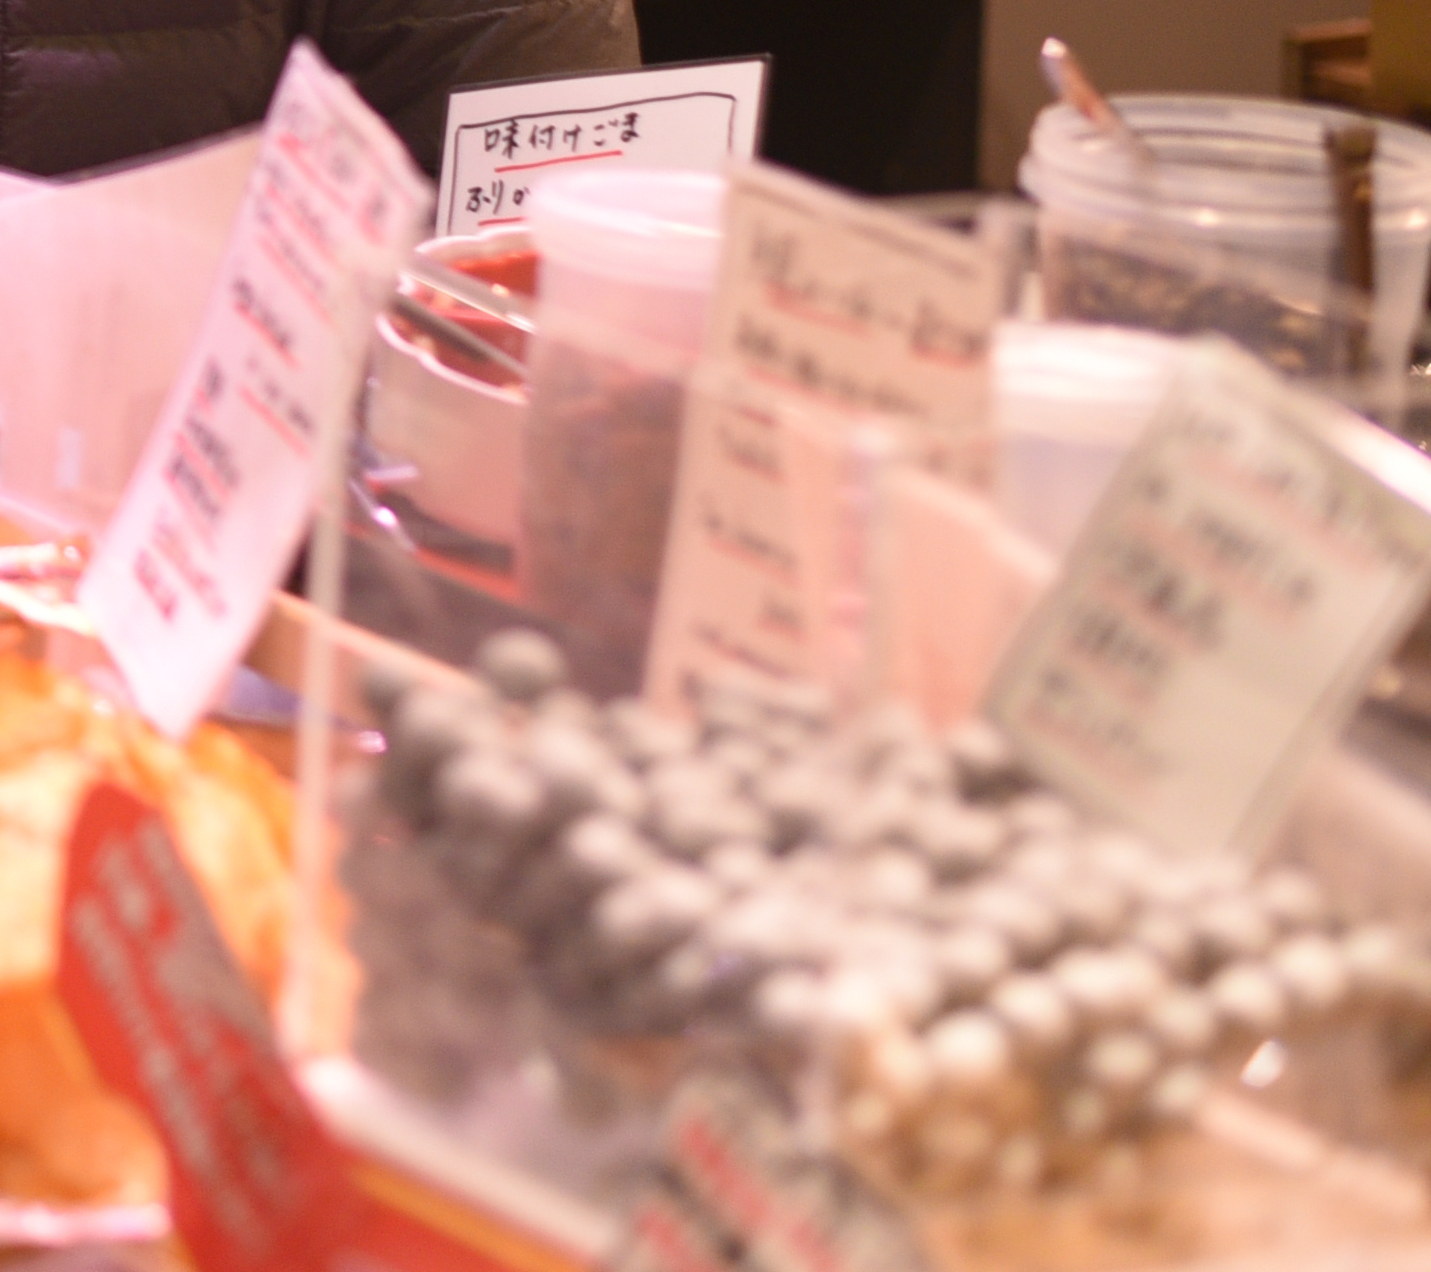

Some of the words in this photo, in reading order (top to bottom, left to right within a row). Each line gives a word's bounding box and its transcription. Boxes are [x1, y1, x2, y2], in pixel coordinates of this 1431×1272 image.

[484, 112, 639, 159] 味付けごま
